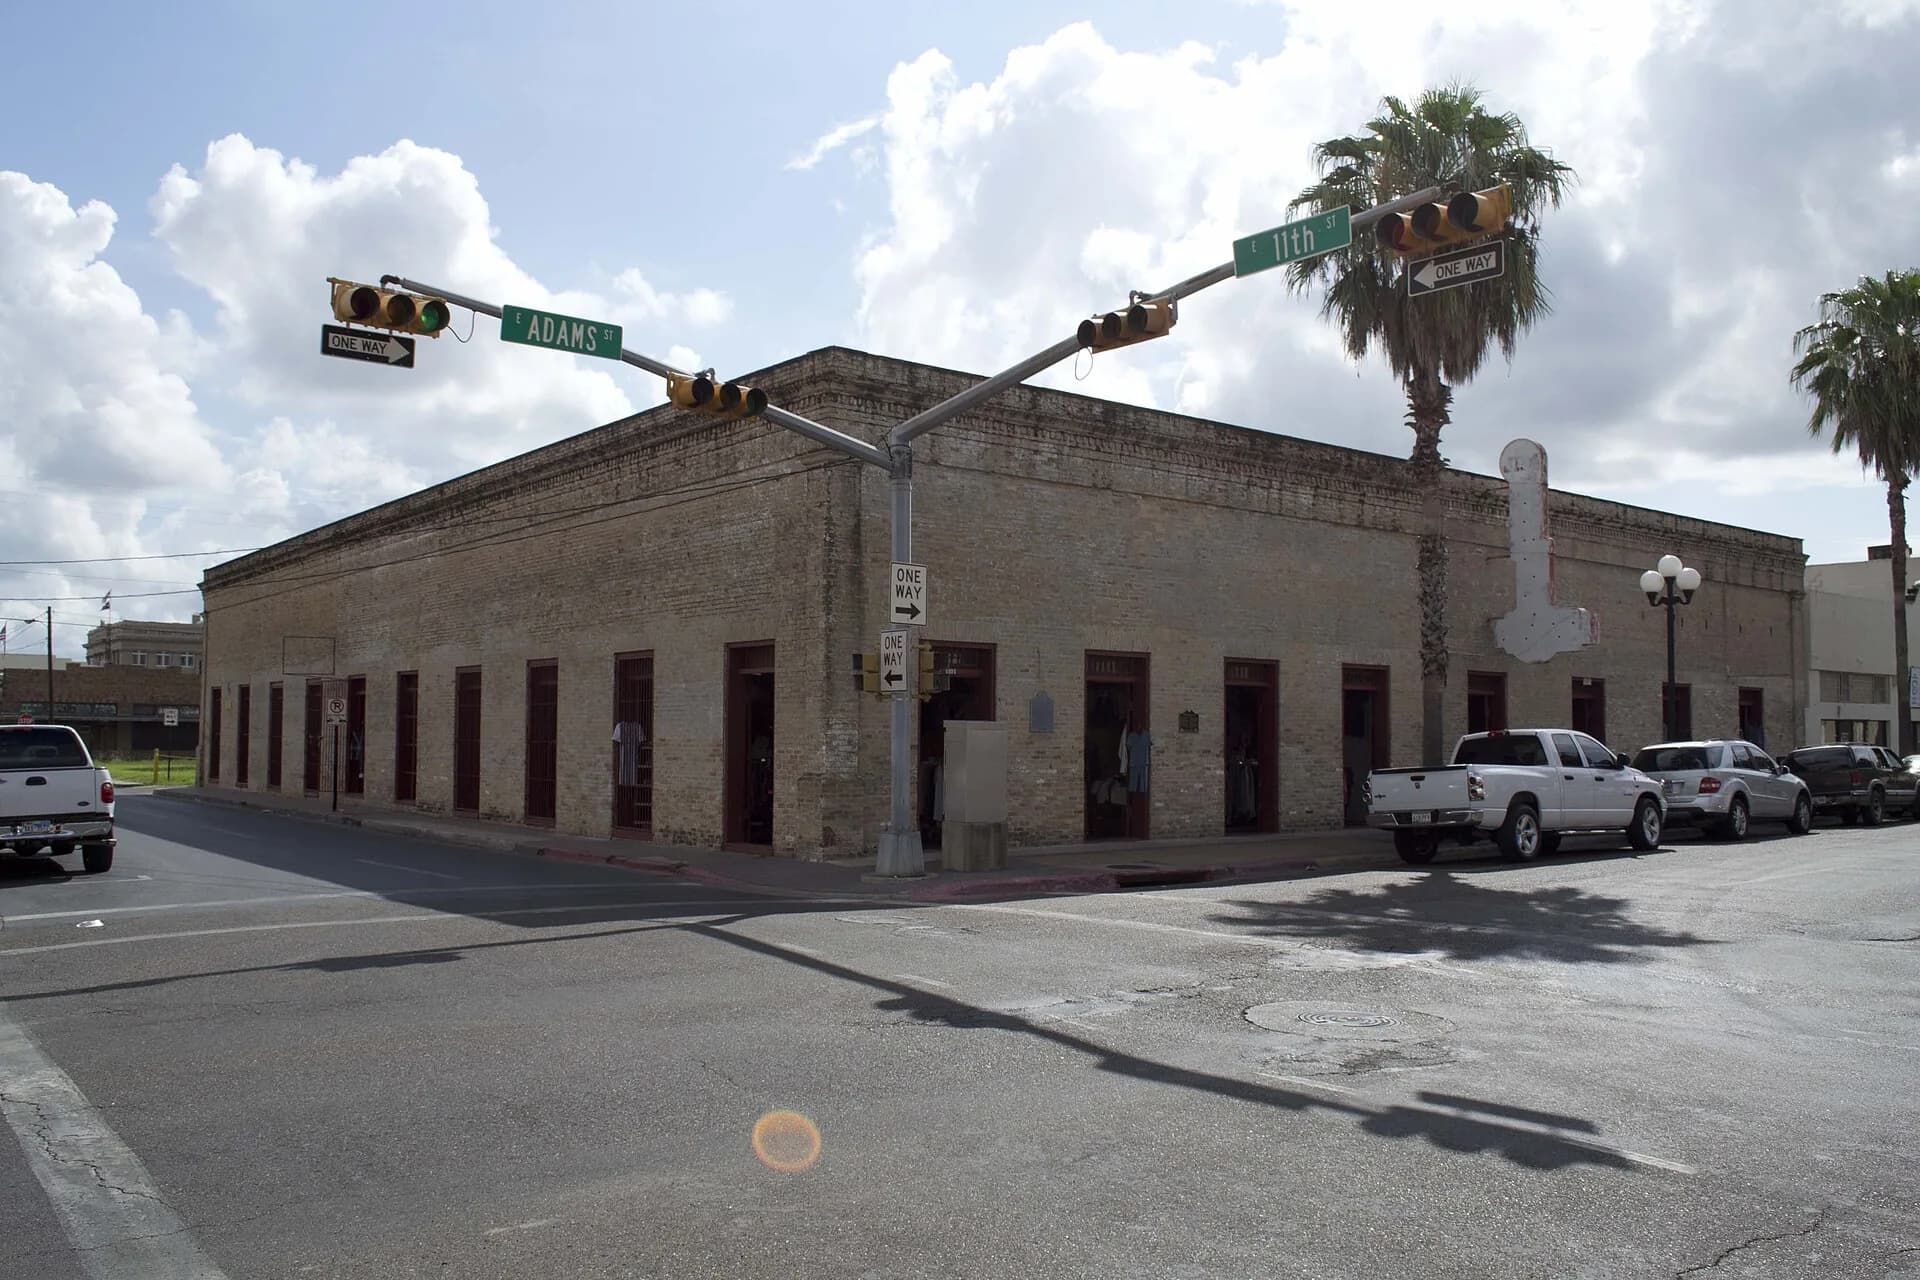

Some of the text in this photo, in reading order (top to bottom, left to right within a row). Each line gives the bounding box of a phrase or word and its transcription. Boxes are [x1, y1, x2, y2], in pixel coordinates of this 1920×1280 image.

[1251, 214, 1337, 261] E 11th ST
[1435, 254, 1493, 279] ONE WAY
[515, 312, 613, 351] E ADAMS ST
[332, 335, 388, 355] ONE WAY
[897, 568, 921, 584] ONE
[896, 584, 922, 600] WAY
[884, 635, 903, 650] ONE
[884, 652, 903, 666] WAY
